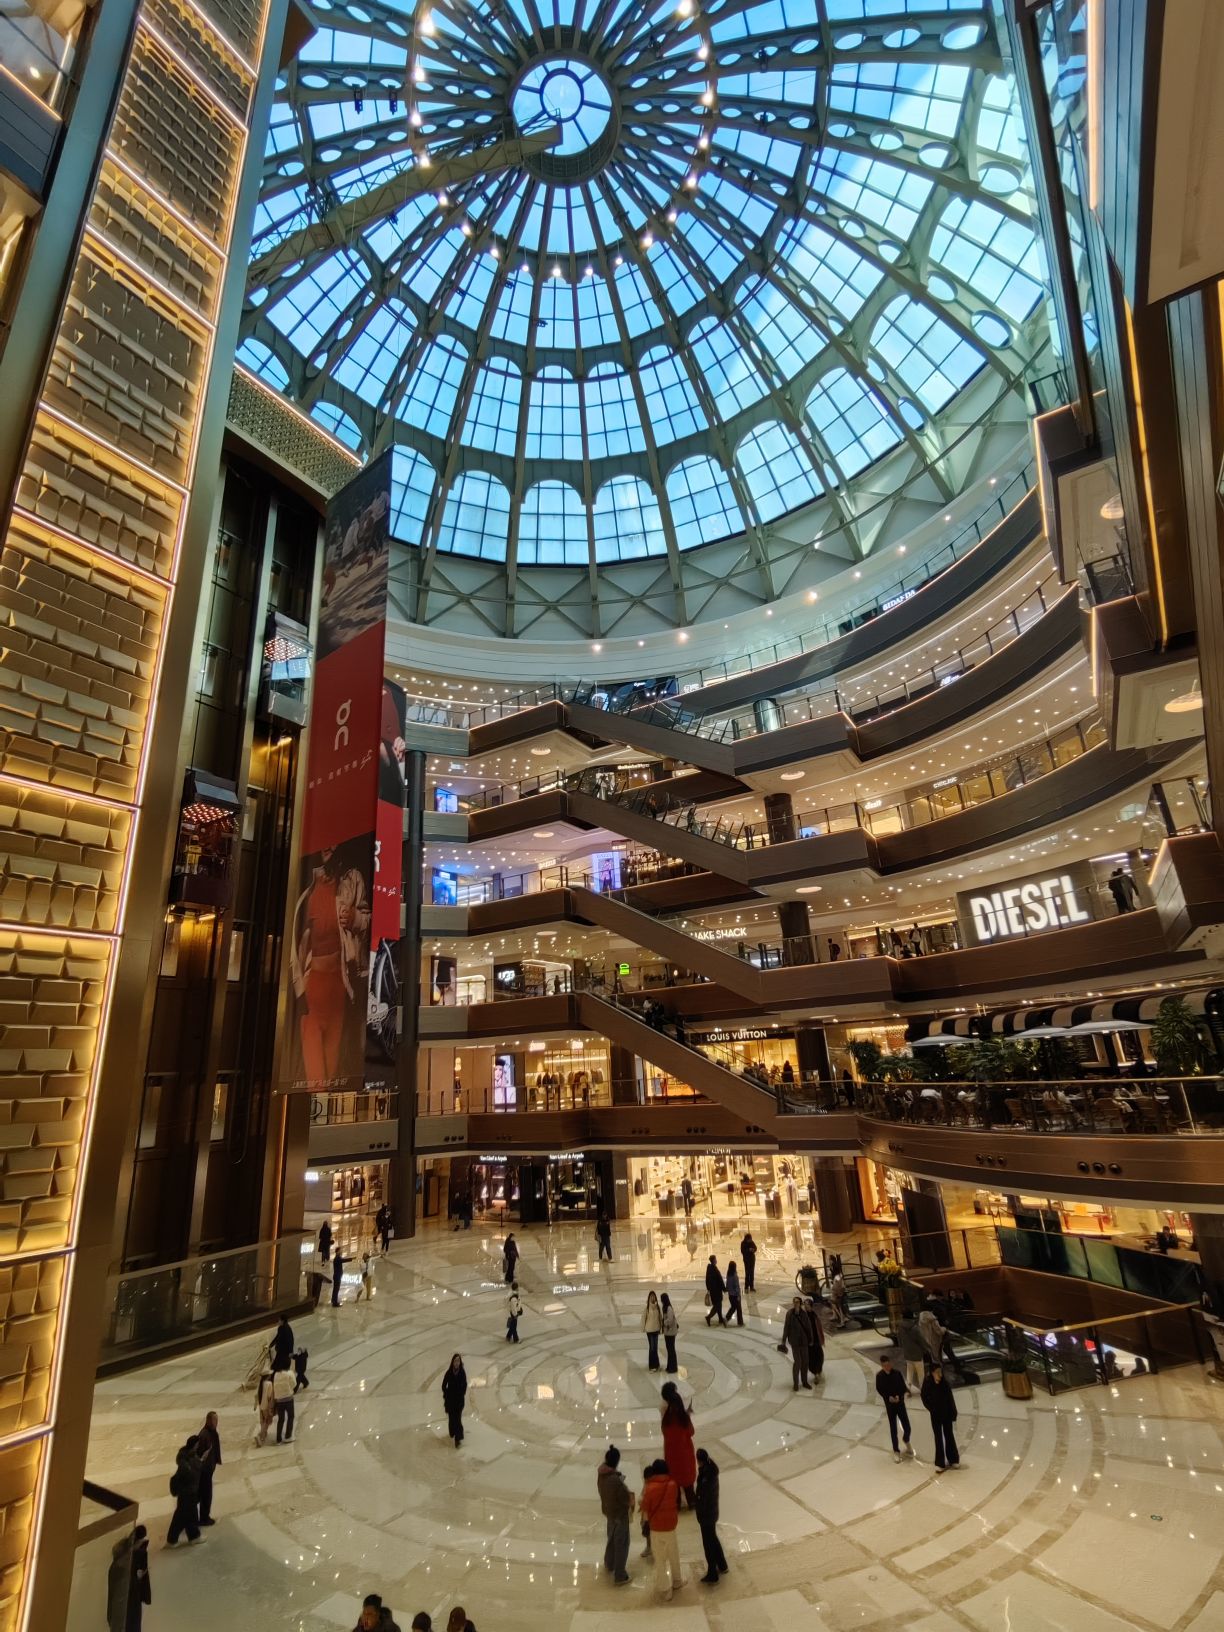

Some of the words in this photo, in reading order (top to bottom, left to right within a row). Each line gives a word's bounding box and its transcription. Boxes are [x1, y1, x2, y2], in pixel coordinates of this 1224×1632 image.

[969, 874, 1089, 941] DIESEL
[690, 930, 715, 941] AKE
[716, 927, 747, 939] SHACK
[706, 1032, 730, 1042] LOUIS
[731, 1029, 767, 1040] VUITTON
